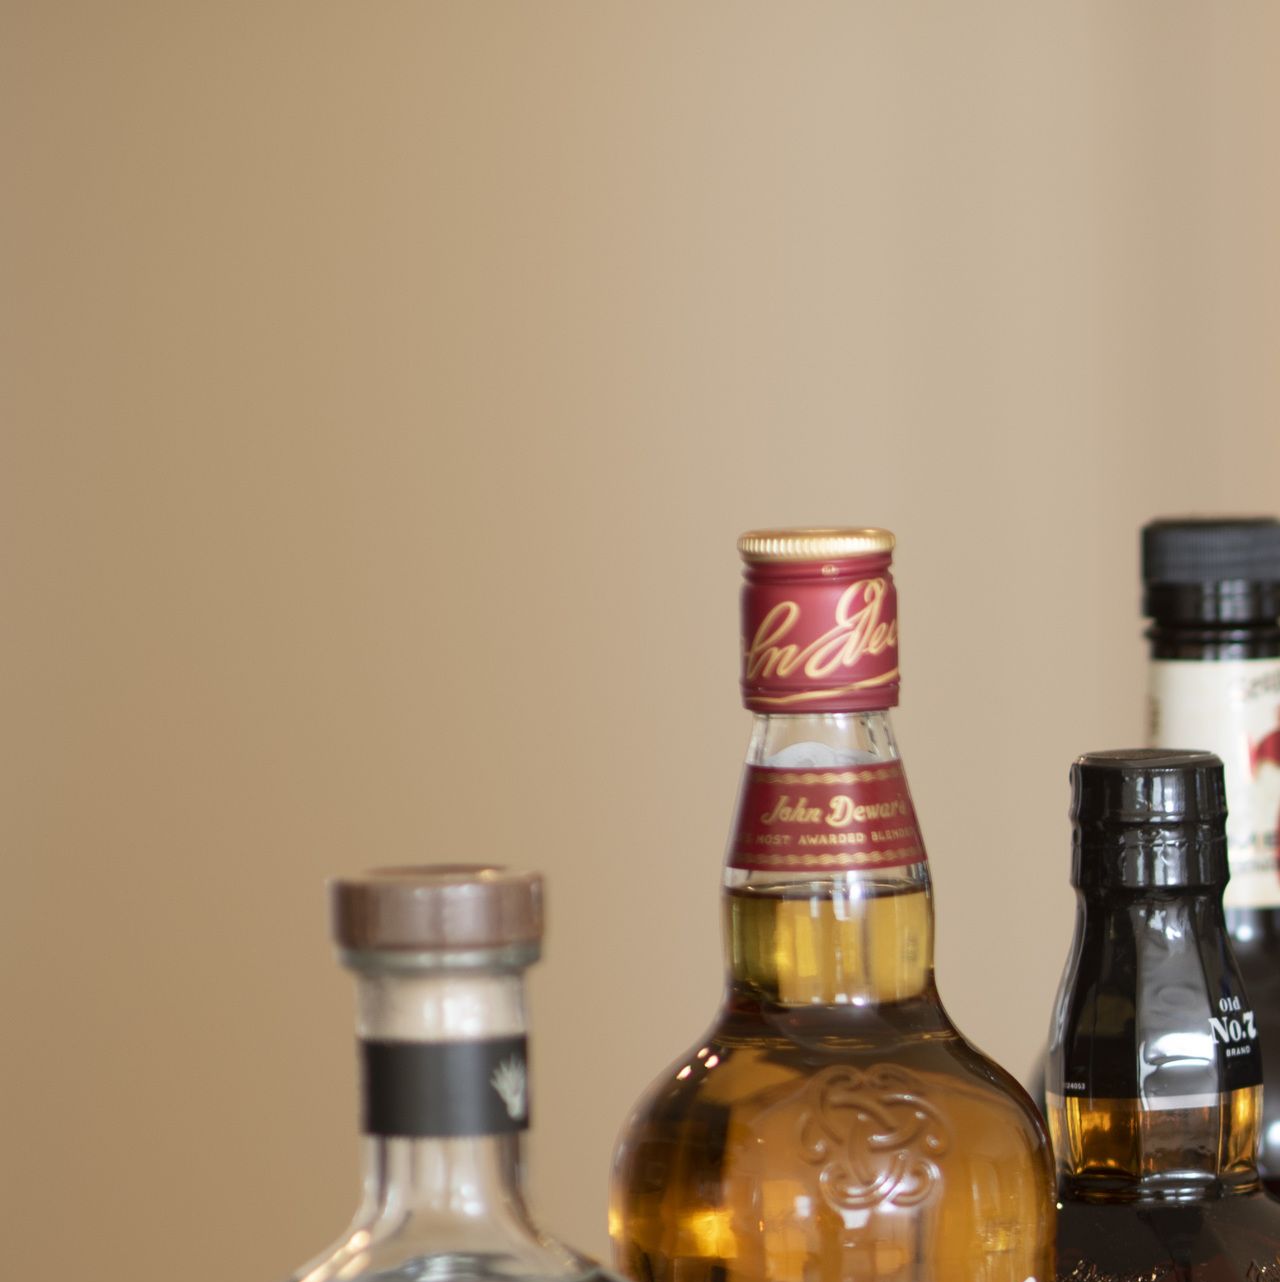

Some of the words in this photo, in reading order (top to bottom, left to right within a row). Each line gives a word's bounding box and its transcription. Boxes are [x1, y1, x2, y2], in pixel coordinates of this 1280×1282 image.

[761, 795, 822, 826] John
[798, 832, 866, 846] AWARDED
[1218, 995, 1241, 1012] Old
[1226, 1045, 1251, 1058] BRAND
